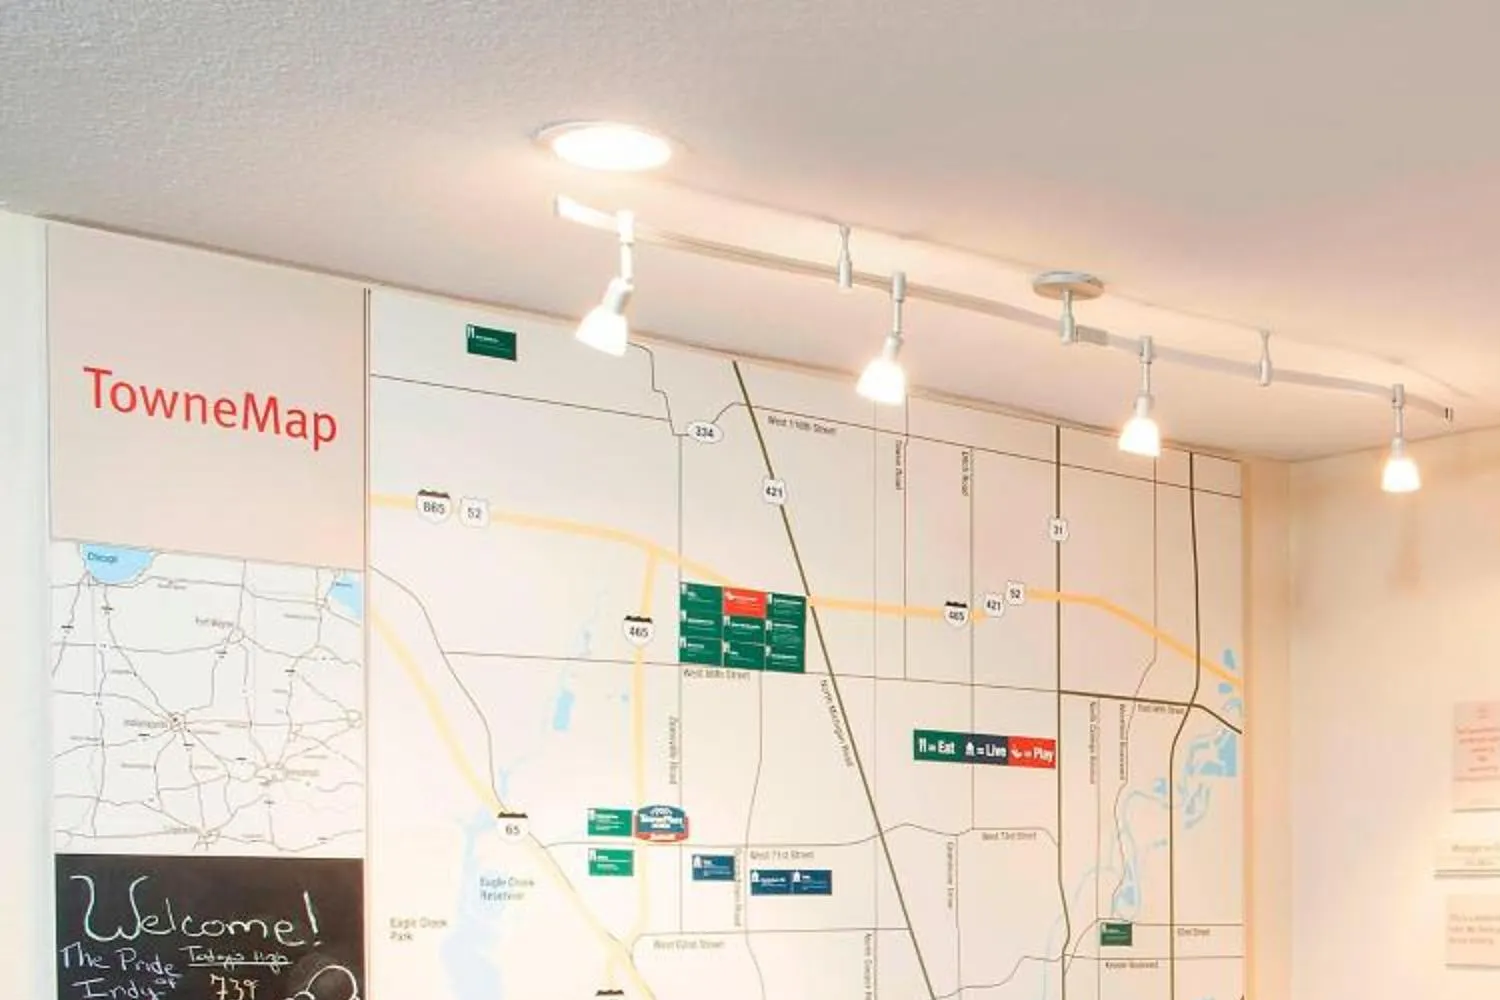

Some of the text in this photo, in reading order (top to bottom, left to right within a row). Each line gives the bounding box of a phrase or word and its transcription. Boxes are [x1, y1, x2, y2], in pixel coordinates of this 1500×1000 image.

[83, 366, 338, 451] TowneMap
[765, 486, 783, 498] 421
[467, 507, 482, 520] 52
[628, 626, 649, 638] 465
[937, 740, 1054, 764] Eat Live Play
[505, 824, 521, 836] 65
[70, 875, 322, 947] Welcome!
[59, 942, 180, 978] The Pride
